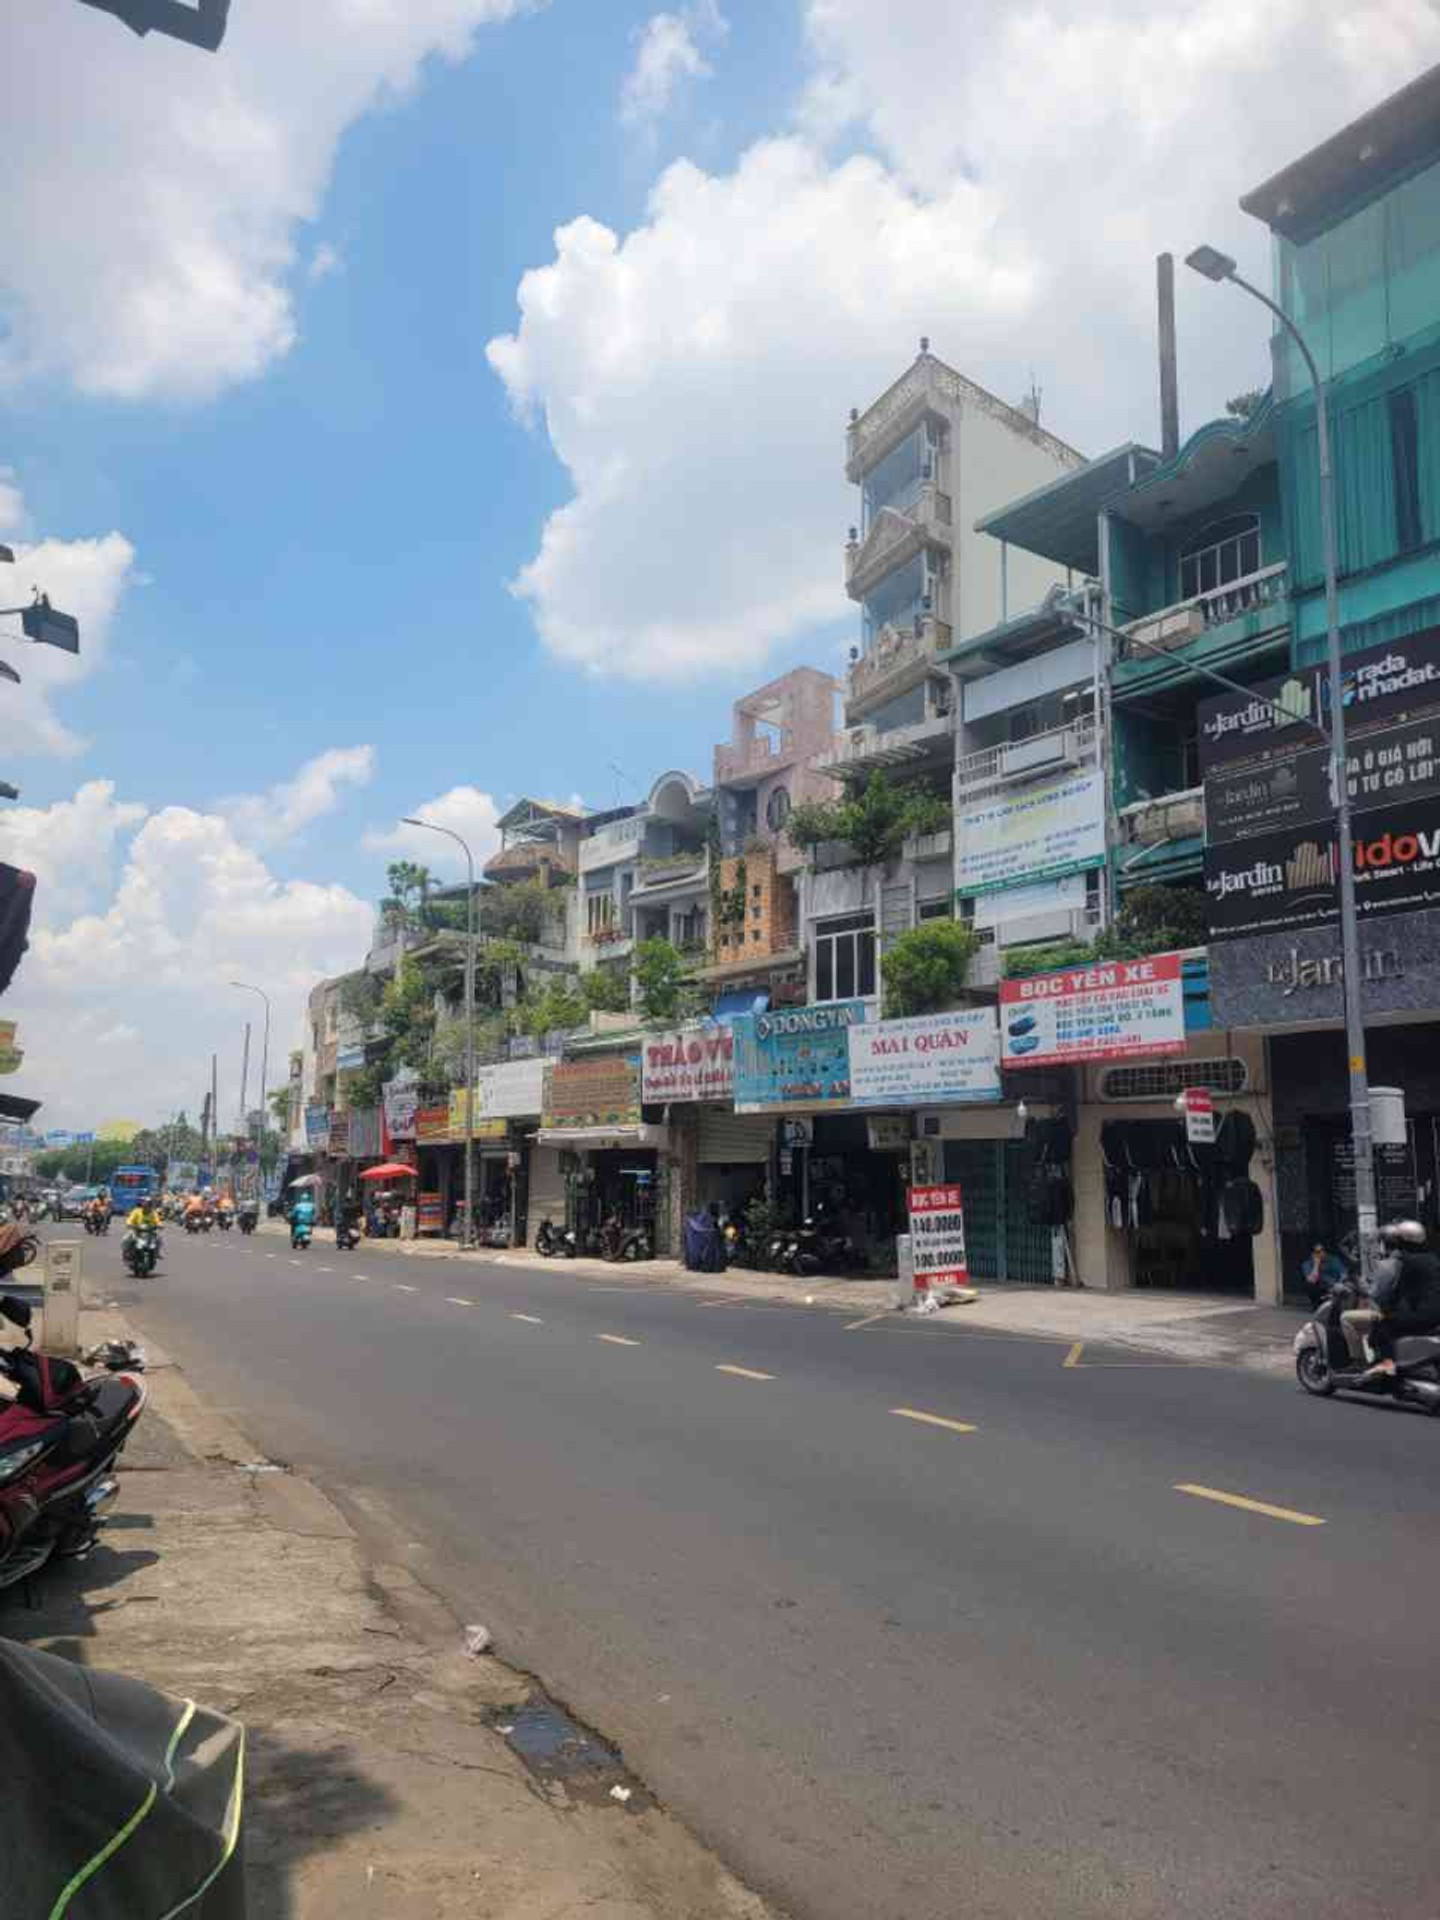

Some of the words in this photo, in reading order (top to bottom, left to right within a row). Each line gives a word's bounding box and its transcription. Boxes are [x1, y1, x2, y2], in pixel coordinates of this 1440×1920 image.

[1357, 654, 1406, 682] rada
[1216, 862, 1283, 900] Jardin
[1124, 962, 1154, 982] XE
